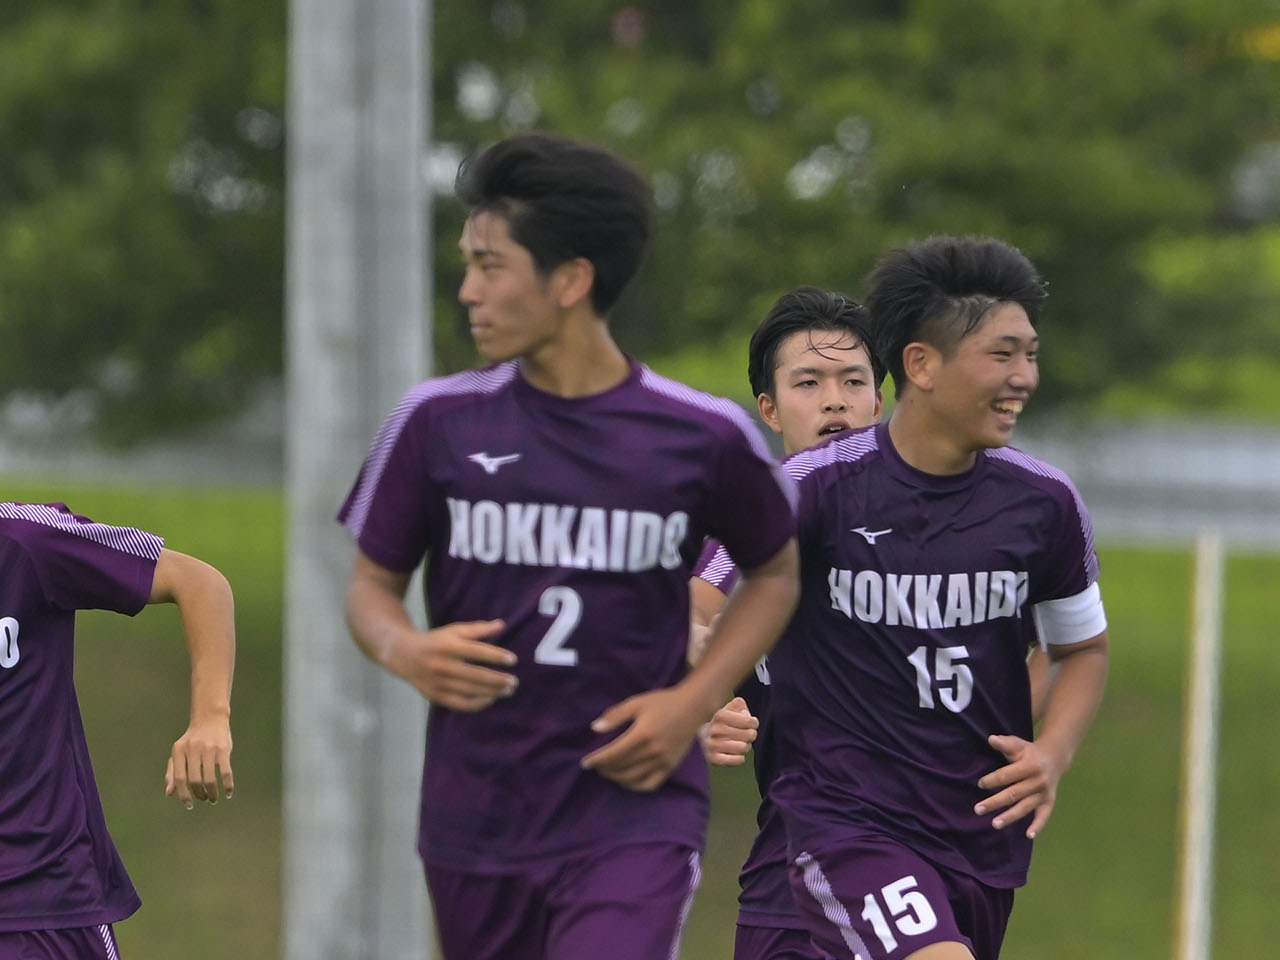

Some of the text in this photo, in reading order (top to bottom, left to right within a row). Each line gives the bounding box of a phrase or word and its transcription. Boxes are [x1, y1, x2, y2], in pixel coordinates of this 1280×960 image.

[447, 497, 689, 573] HOKKAIDO
[534, 585, 582, 666] 2
[907, 645, 973, 713] 15
[861, 875, 938, 954] 15
